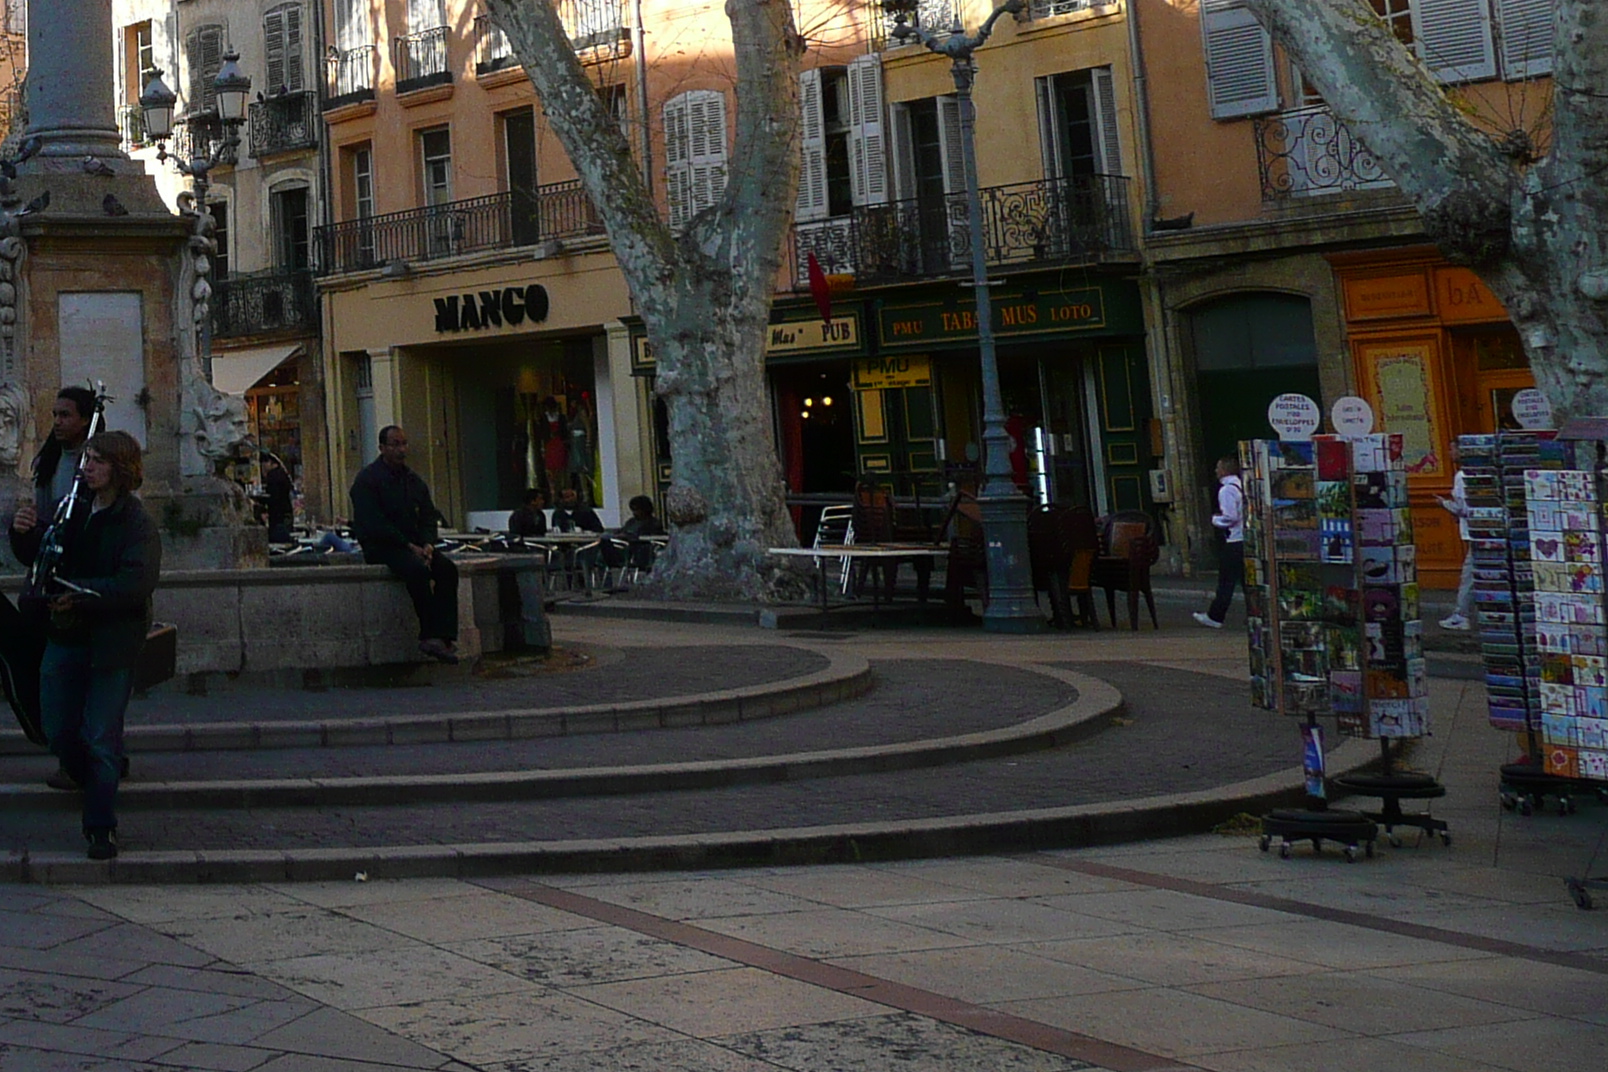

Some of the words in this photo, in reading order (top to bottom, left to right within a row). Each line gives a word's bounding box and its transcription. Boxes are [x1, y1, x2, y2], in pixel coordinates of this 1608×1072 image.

[433, 284, 549, 333] MANGO
[892, 320, 924, 336] PMU
[1001, 304, 1038, 327] MUS
[1050, 304, 1092, 322] LOTO
[821, 322, 851, 342] PUB
[867, 358, 910, 374] PMU
